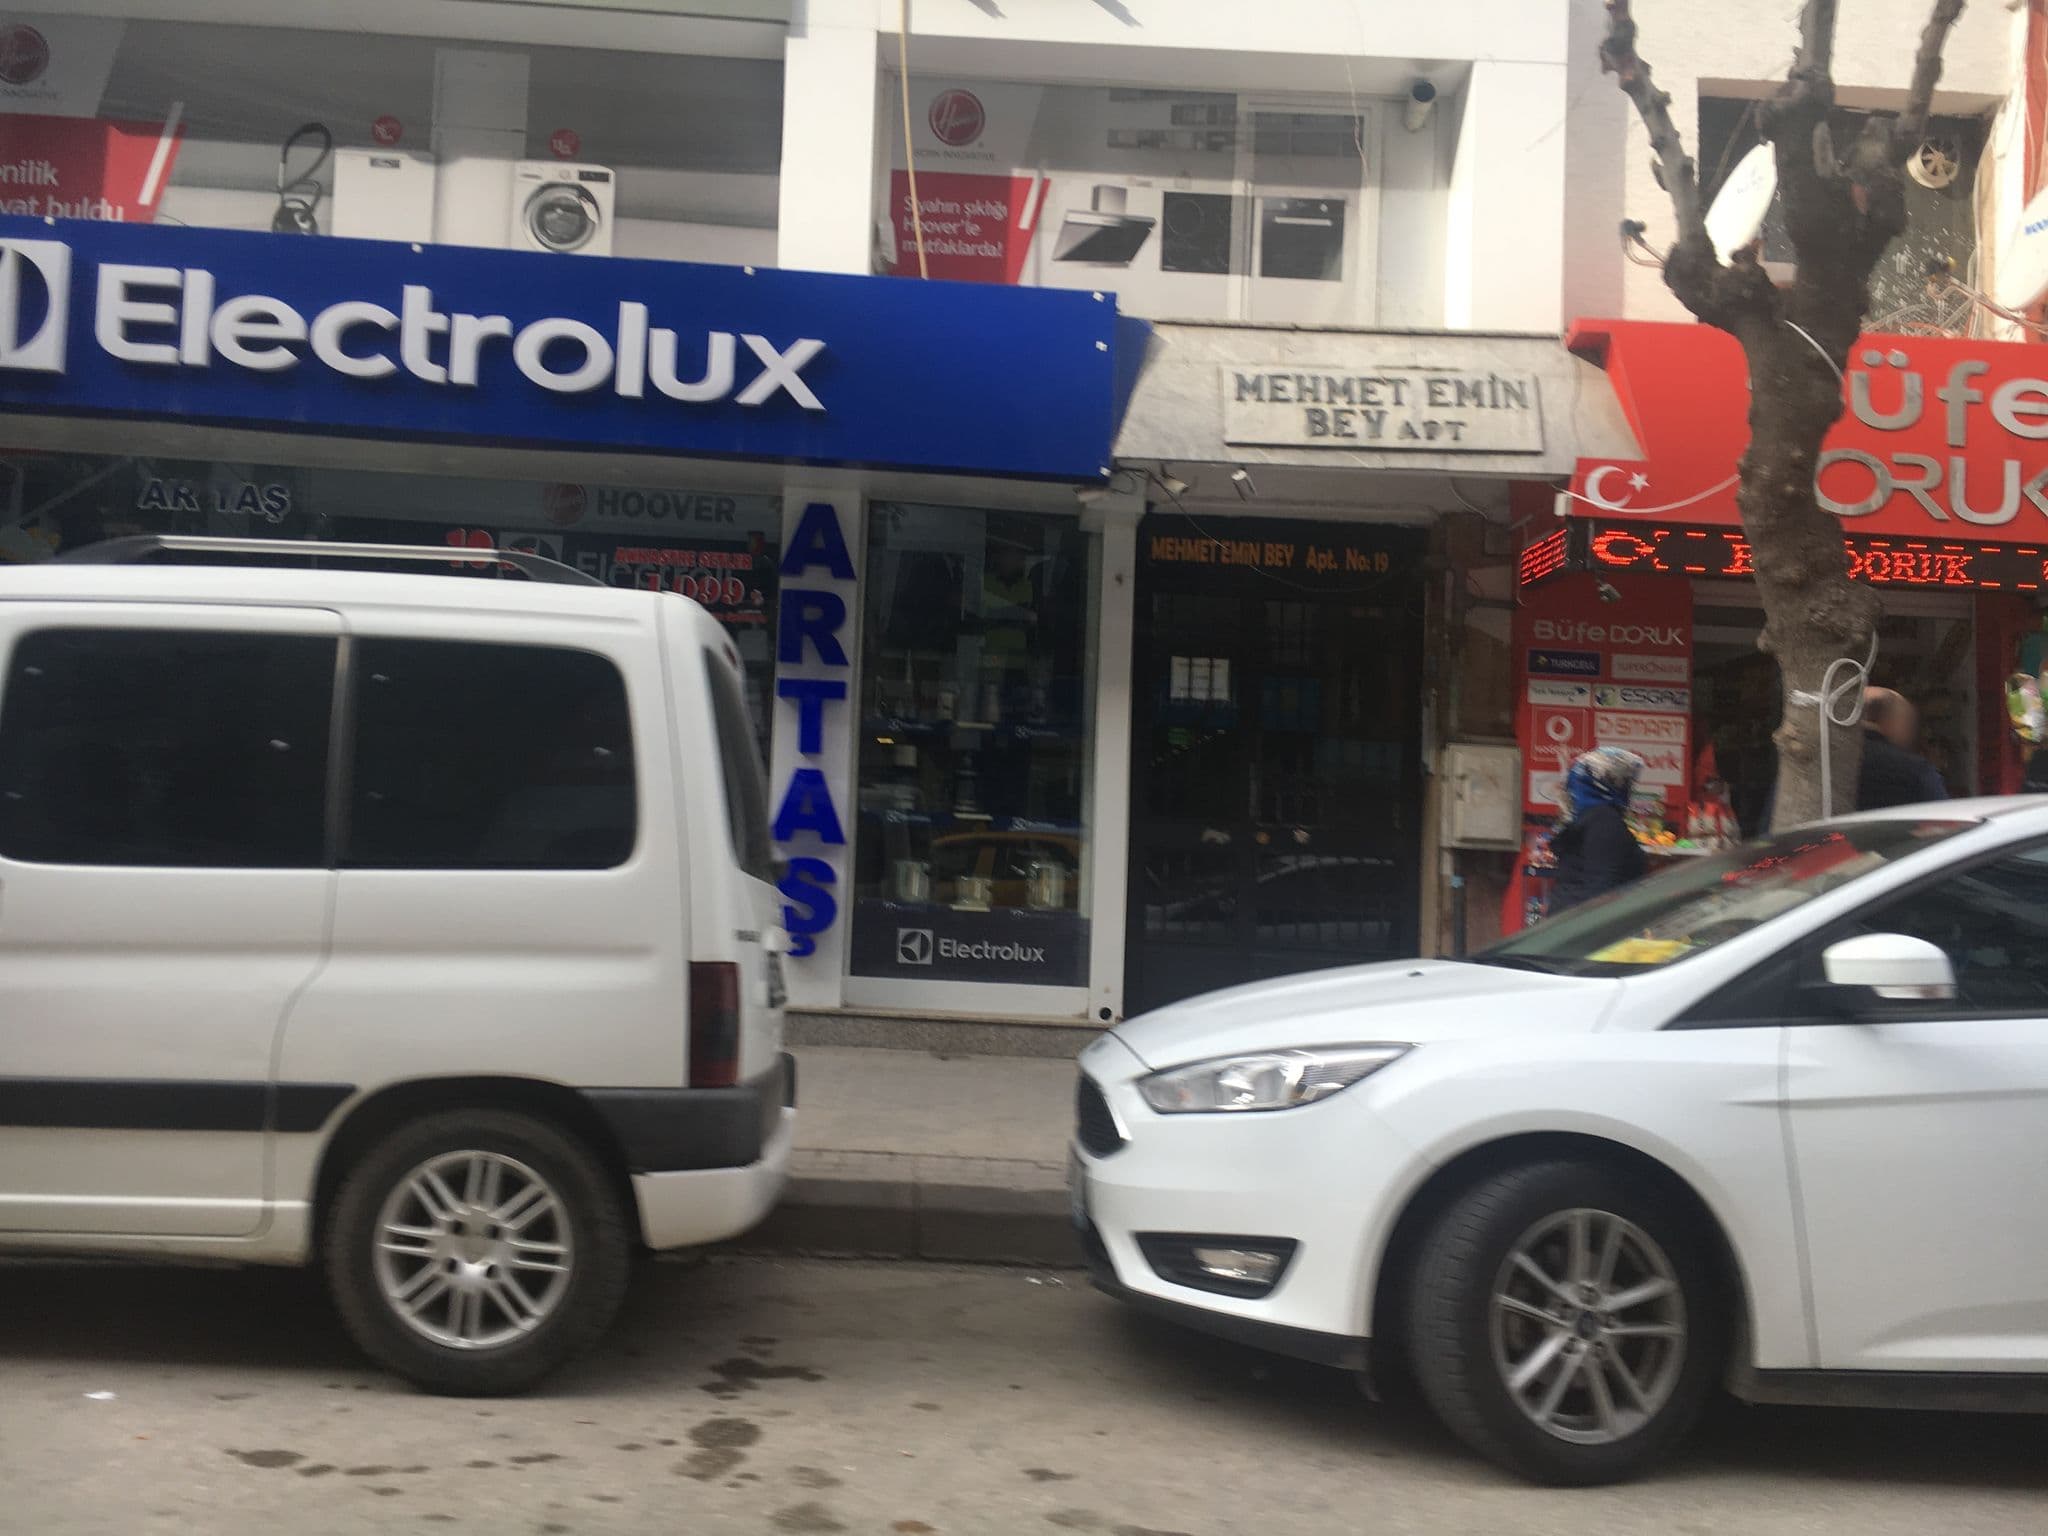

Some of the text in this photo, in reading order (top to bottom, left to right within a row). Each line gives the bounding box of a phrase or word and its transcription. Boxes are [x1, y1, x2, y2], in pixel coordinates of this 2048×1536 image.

[0, 160, 59, 187] nilik
[94, 263, 827, 411] Electrolux
[1233, 372, 1529, 409] MEHMET EMİN
[1849, 349, 2048, 447] üfe
[1304, 407, 1467, 441] BEY APT
[1814, 448, 2048, 525] ORU
[597, 488, 737, 524] HOOVER
[1151, 536, 1217, 563] MEHMET
[1264, 543, 1295, 568] BEY
[1307, 545, 1338, 574] Apt.
[1533, 619, 1685, 647] Büfe DORUK
[769, 503, 857, 958] ARTAŞ
[939, 937, 1045, 963] Electrolux
